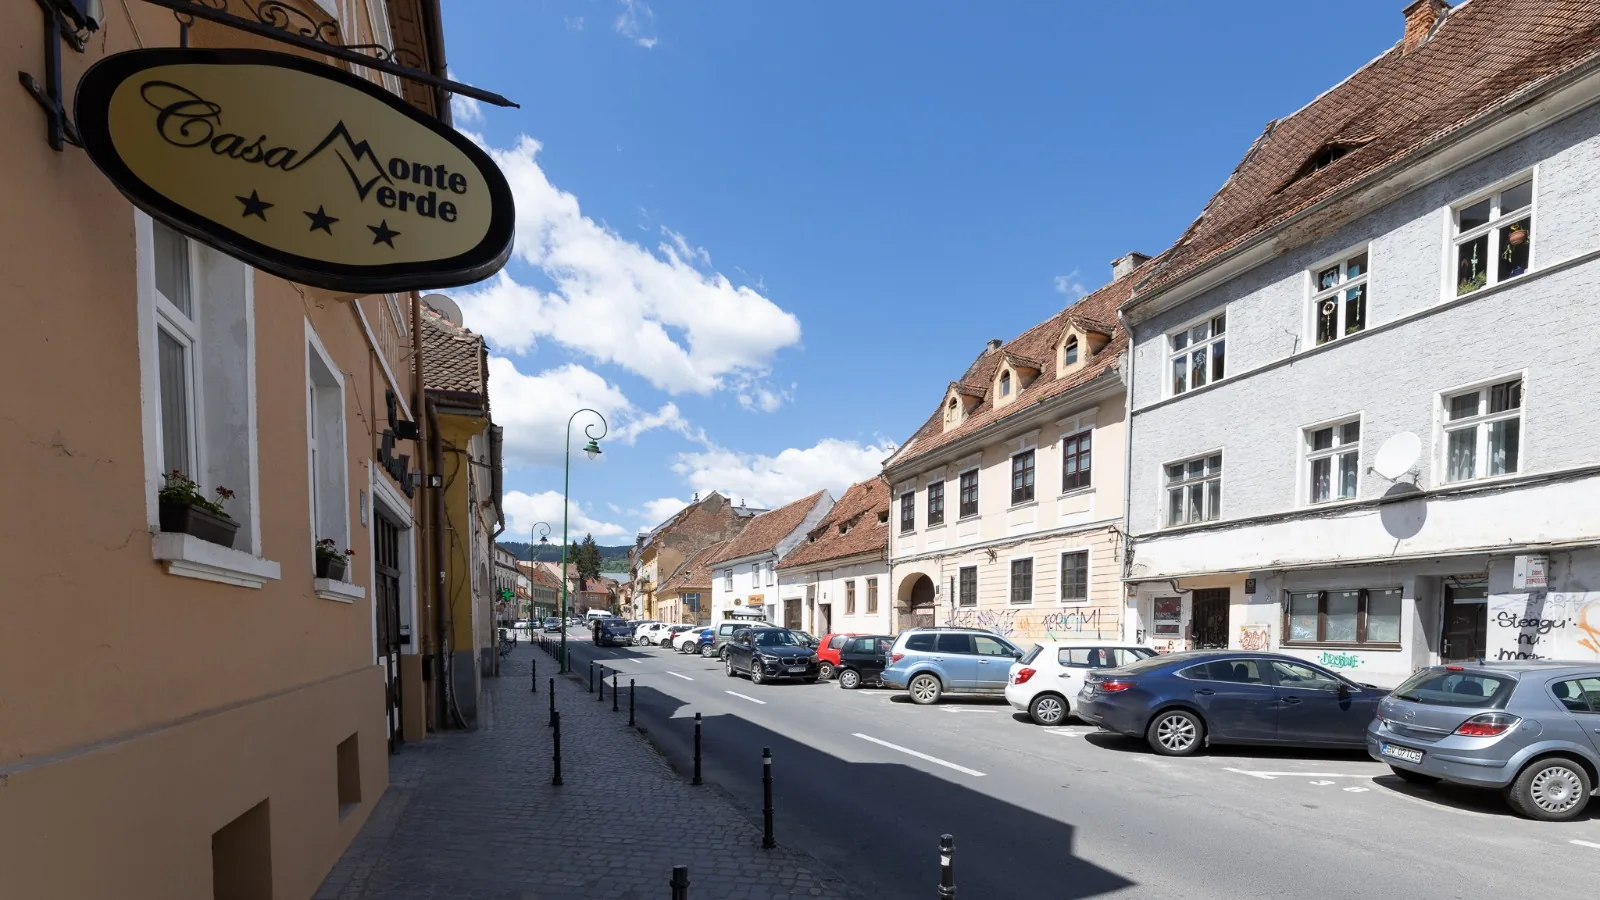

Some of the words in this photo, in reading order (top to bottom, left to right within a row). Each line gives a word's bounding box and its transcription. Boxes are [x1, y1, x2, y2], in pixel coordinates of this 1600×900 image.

[140, 80, 301, 172] Casa
[298, 119, 468, 195] Monte
[333, 148, 459, 223] Verde
